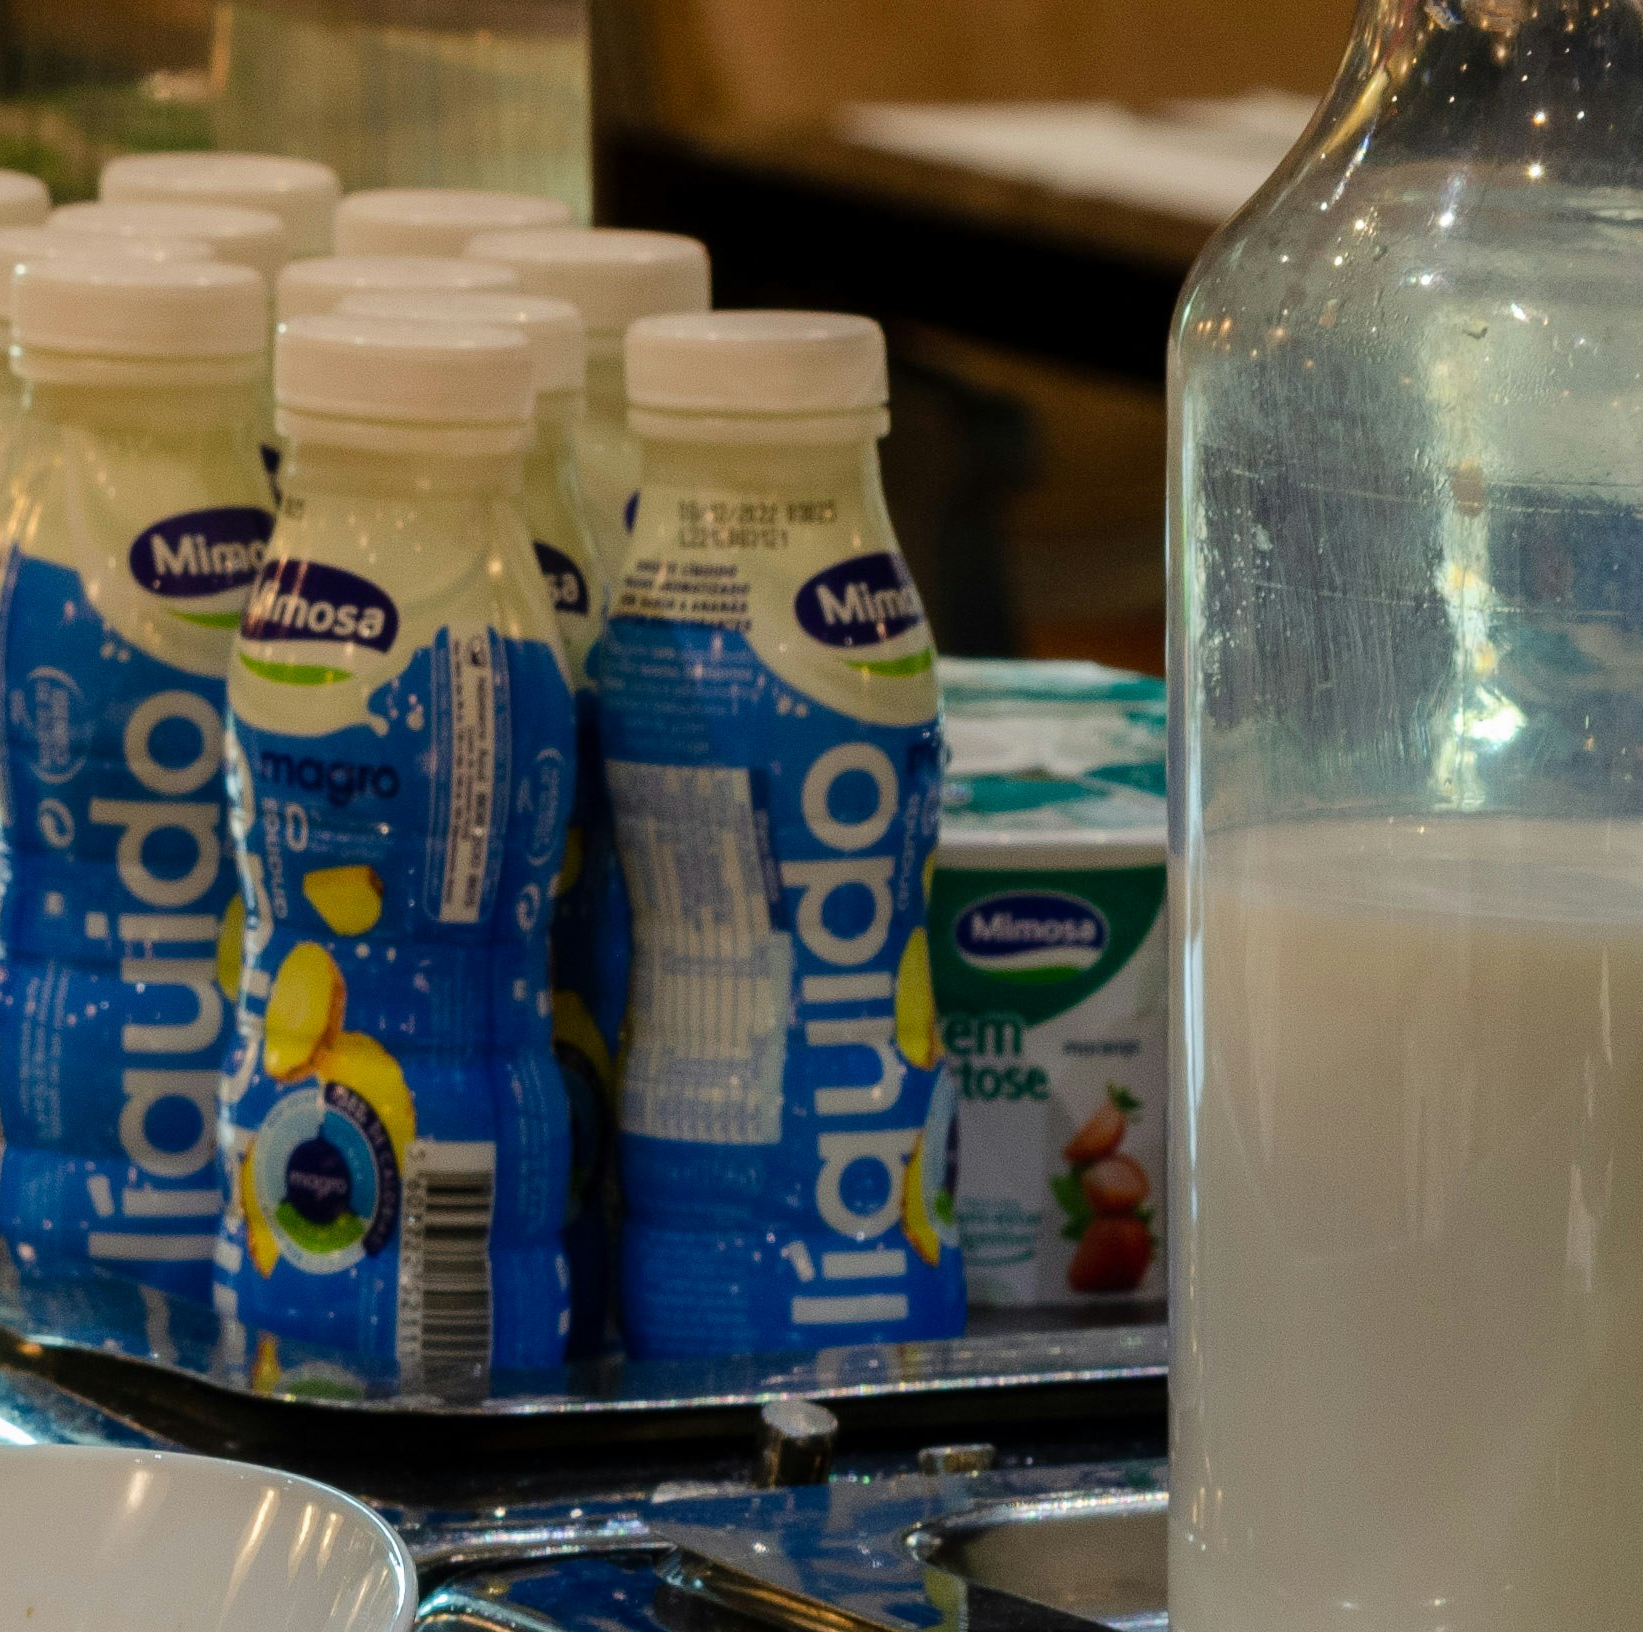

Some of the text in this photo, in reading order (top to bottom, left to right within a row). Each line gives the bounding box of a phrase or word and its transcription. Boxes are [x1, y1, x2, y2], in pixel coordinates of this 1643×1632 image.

[149, 531, 267, 578] Mimo
[814, 580, 922, 626] Mimo
[260, 749, 400, 807] magro
[970, 911, 1098, 945] Mimosa
[88, 690, 226, 1261] líquido
[781, 741, 922, 1325] líquido
[944, 1011, 1024, 1056] em
[957, 1062, 1049, 1101] tose
